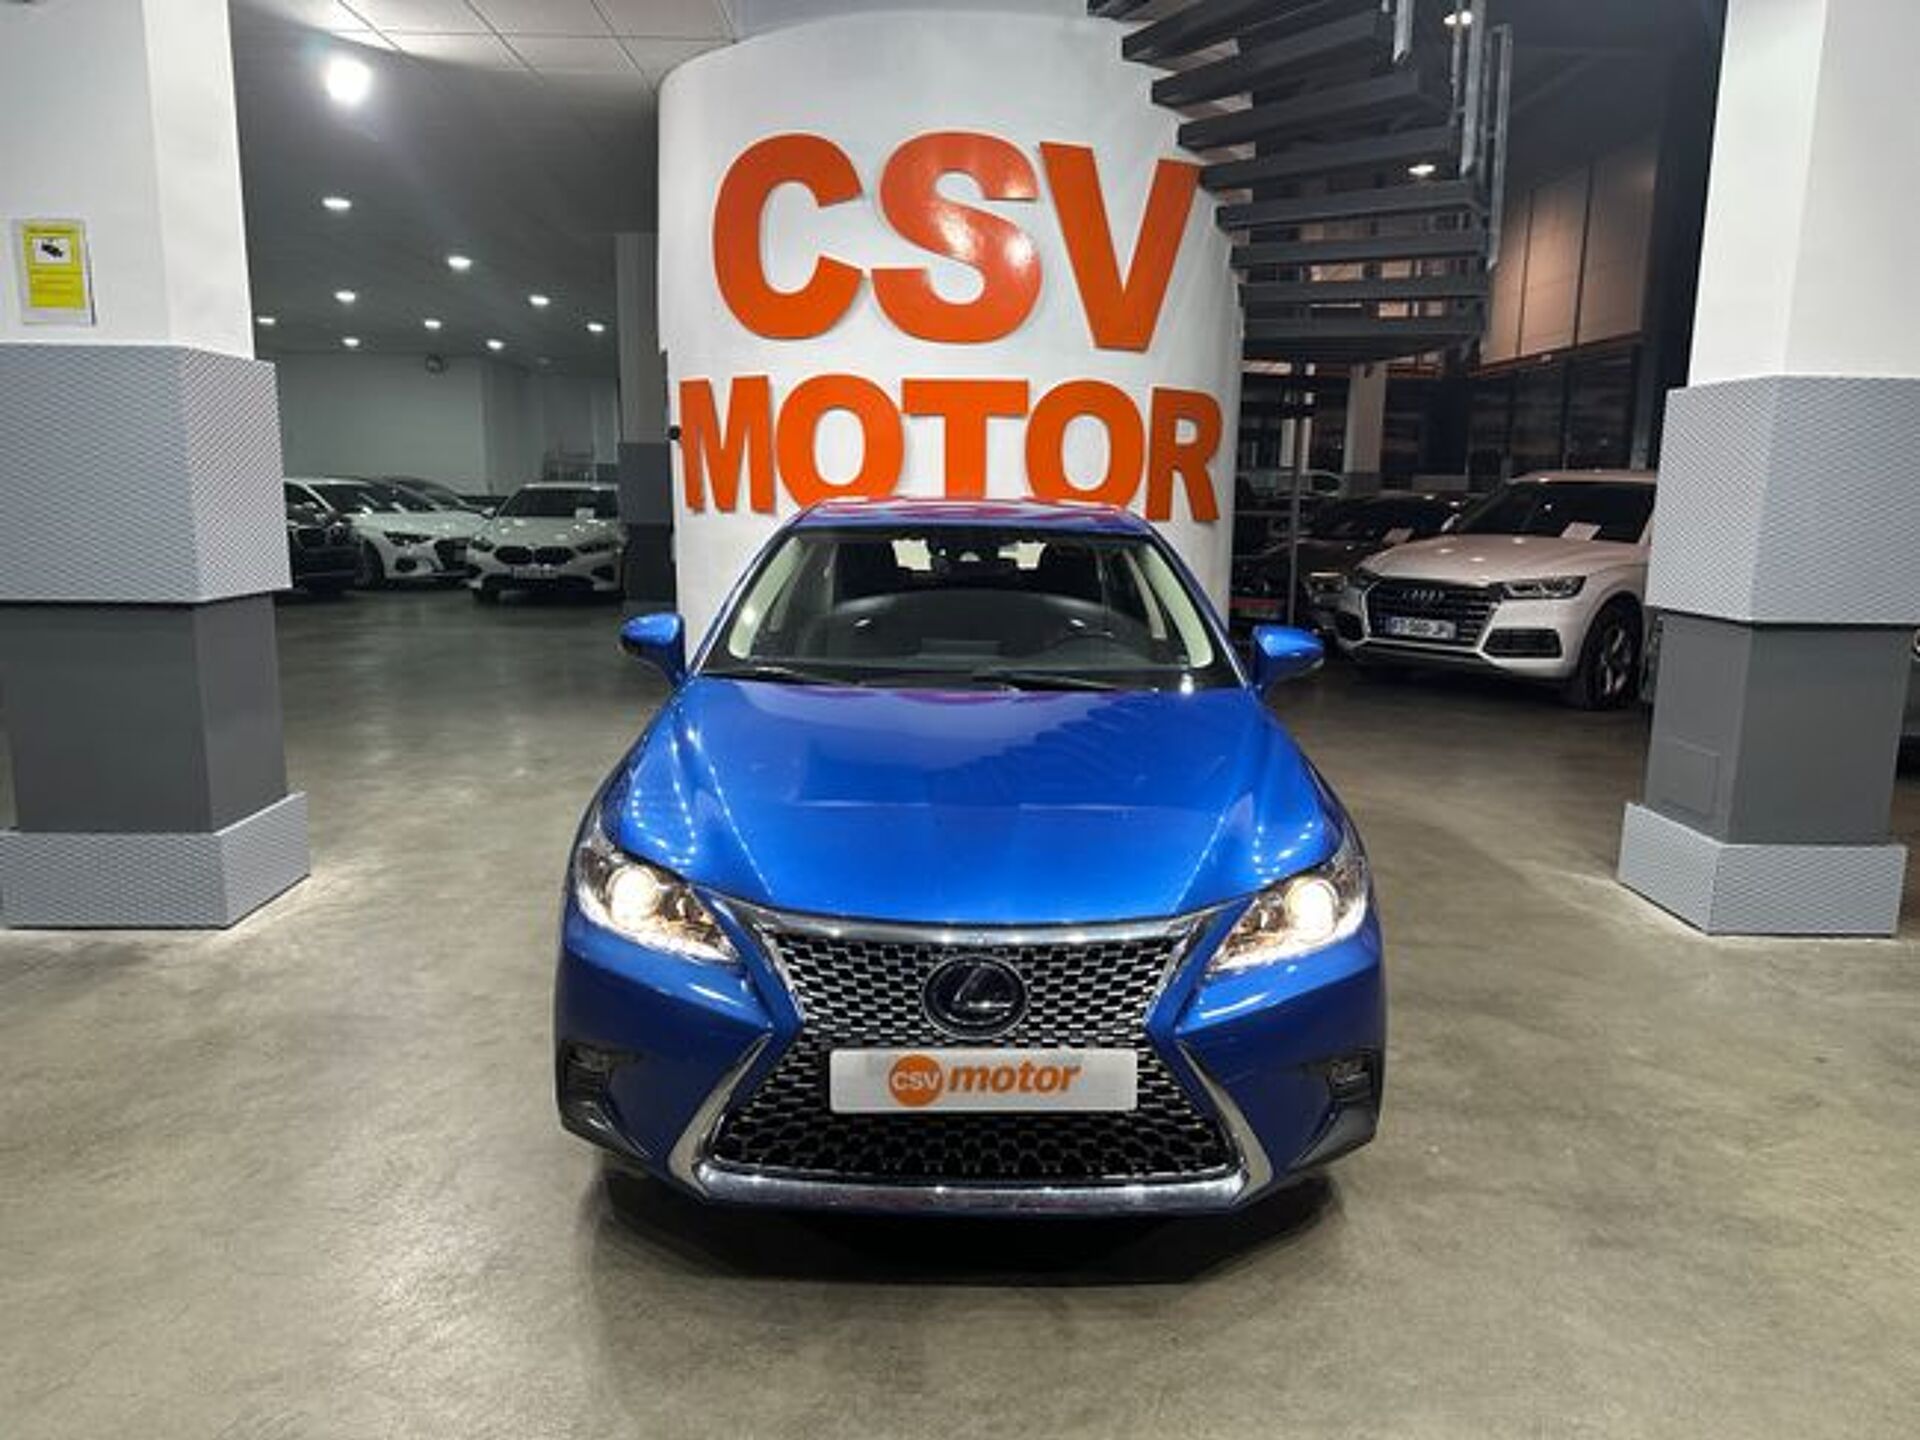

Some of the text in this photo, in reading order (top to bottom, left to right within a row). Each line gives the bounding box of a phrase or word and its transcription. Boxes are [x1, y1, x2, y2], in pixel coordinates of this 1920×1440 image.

[712, 131, 1201, 353] CSV
[679, 373, 1222, 522] MOTOR
[892, 1060, 1081, 1093] CSV motor
